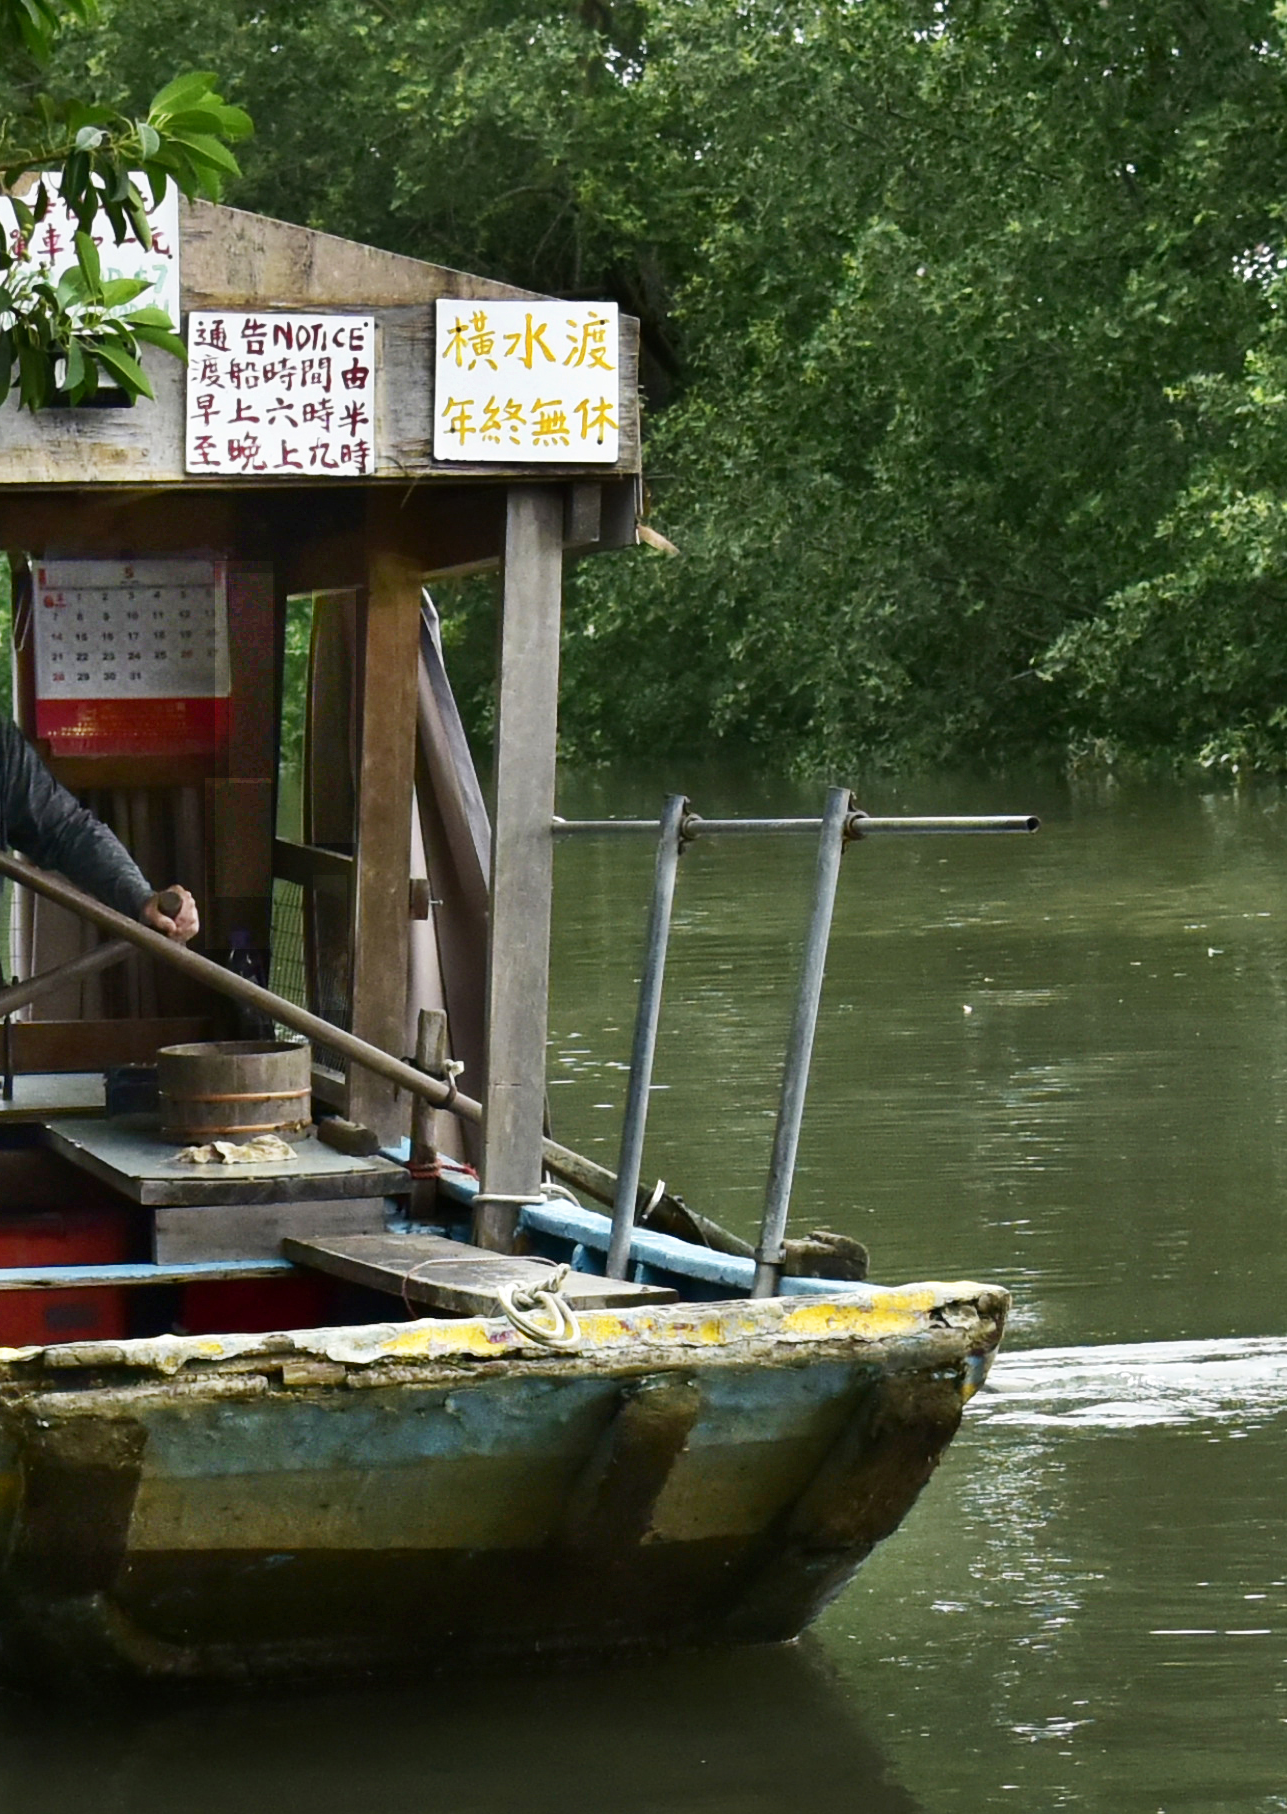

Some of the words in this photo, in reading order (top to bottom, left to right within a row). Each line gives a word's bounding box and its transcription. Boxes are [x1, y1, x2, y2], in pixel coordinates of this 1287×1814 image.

[194, 318, 267, 355] 通告
[273, 321, 365, 352] NOTICE
[442, 310, 617, 371] 橫水渡
[190, 354, 370, 393] 渡船時間由
[190, 393, 369, 437] 早上六時半
[441, 395, 619, 446] 年終無休
[189, 431, 370, 475] 至晚上九時
